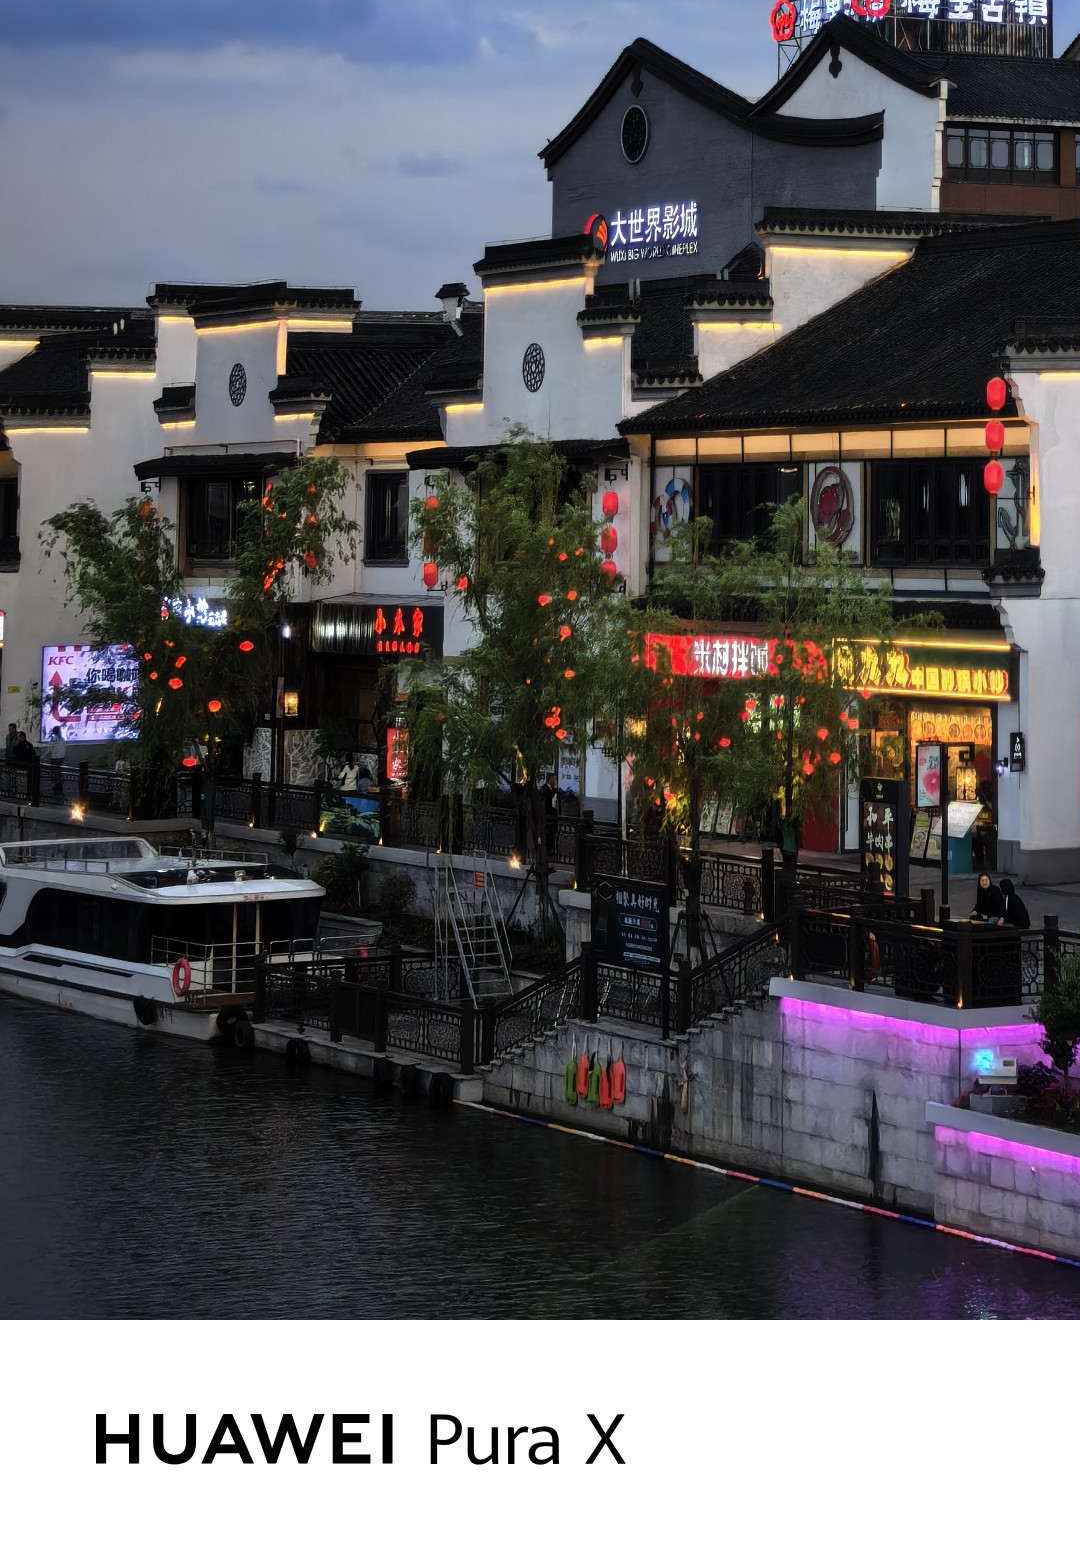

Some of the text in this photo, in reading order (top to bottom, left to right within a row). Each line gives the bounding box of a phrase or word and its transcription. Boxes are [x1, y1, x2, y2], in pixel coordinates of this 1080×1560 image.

[610, 201, 698, 246] 大世界影城
[48, 656, 75, 665] KFC
[693, 639, 769, 677] 米村拌饭
[866, 831, 894, 857] 牛肉串
